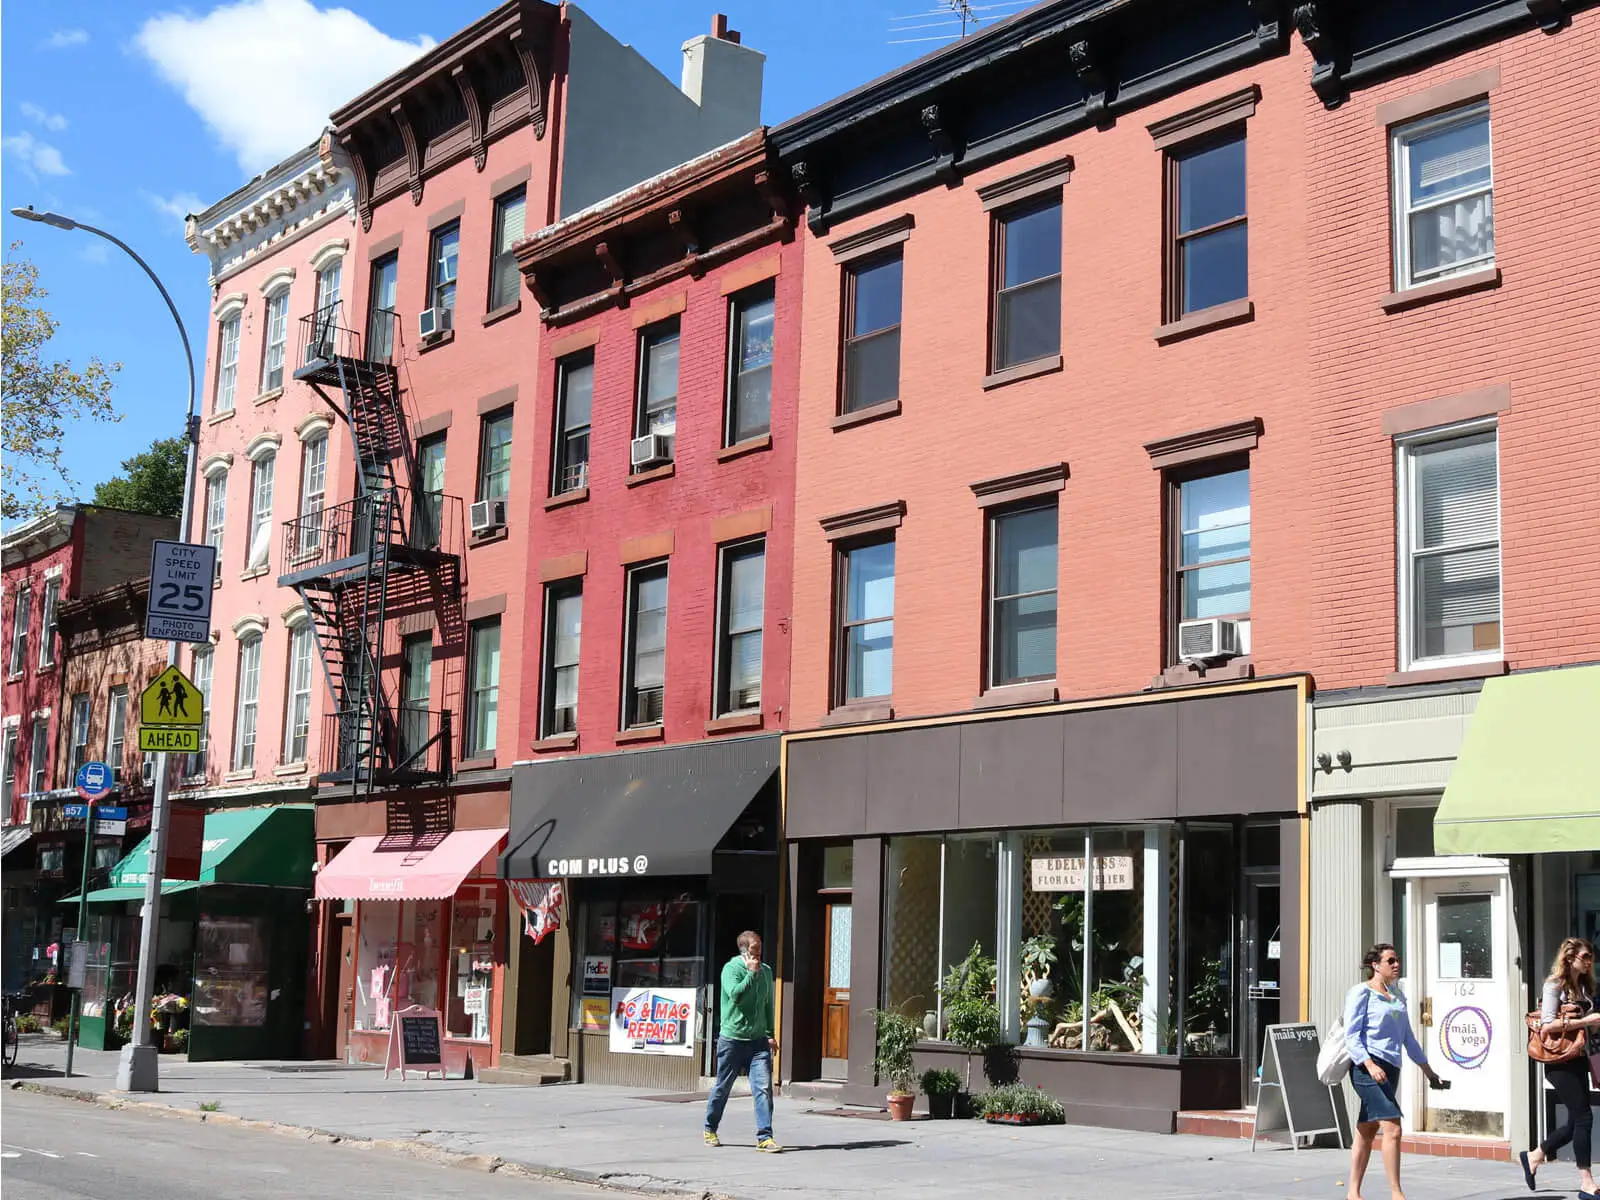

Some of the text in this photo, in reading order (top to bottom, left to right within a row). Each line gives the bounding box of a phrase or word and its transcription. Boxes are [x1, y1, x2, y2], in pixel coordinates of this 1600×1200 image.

[171, 547, 197, 557] CITY
[165, 558, 201, 570] SPEED
[168, 569, 197, 581] LIMIT
[158, 582, 204, 611] 25
[162, 619, 194, 630] PHOTO
[152, 627, 203, 640] ENFORCED
[147, 732, 192, 747] AHEAD
[65, 806, 82, 816] B57
[548, 854, 648, 876] COM PLUS @
[586, 960, 608, 975] FedEx
[1454, 983, 1475, 996] 162
[615, 1001, 691, 1020] PC & MAC
[626, 1021, 677, 1040] REPAIR
[1296, 1029, 1317, 1041] yoga
[1460, 1035, 1486, 1047] yoga
